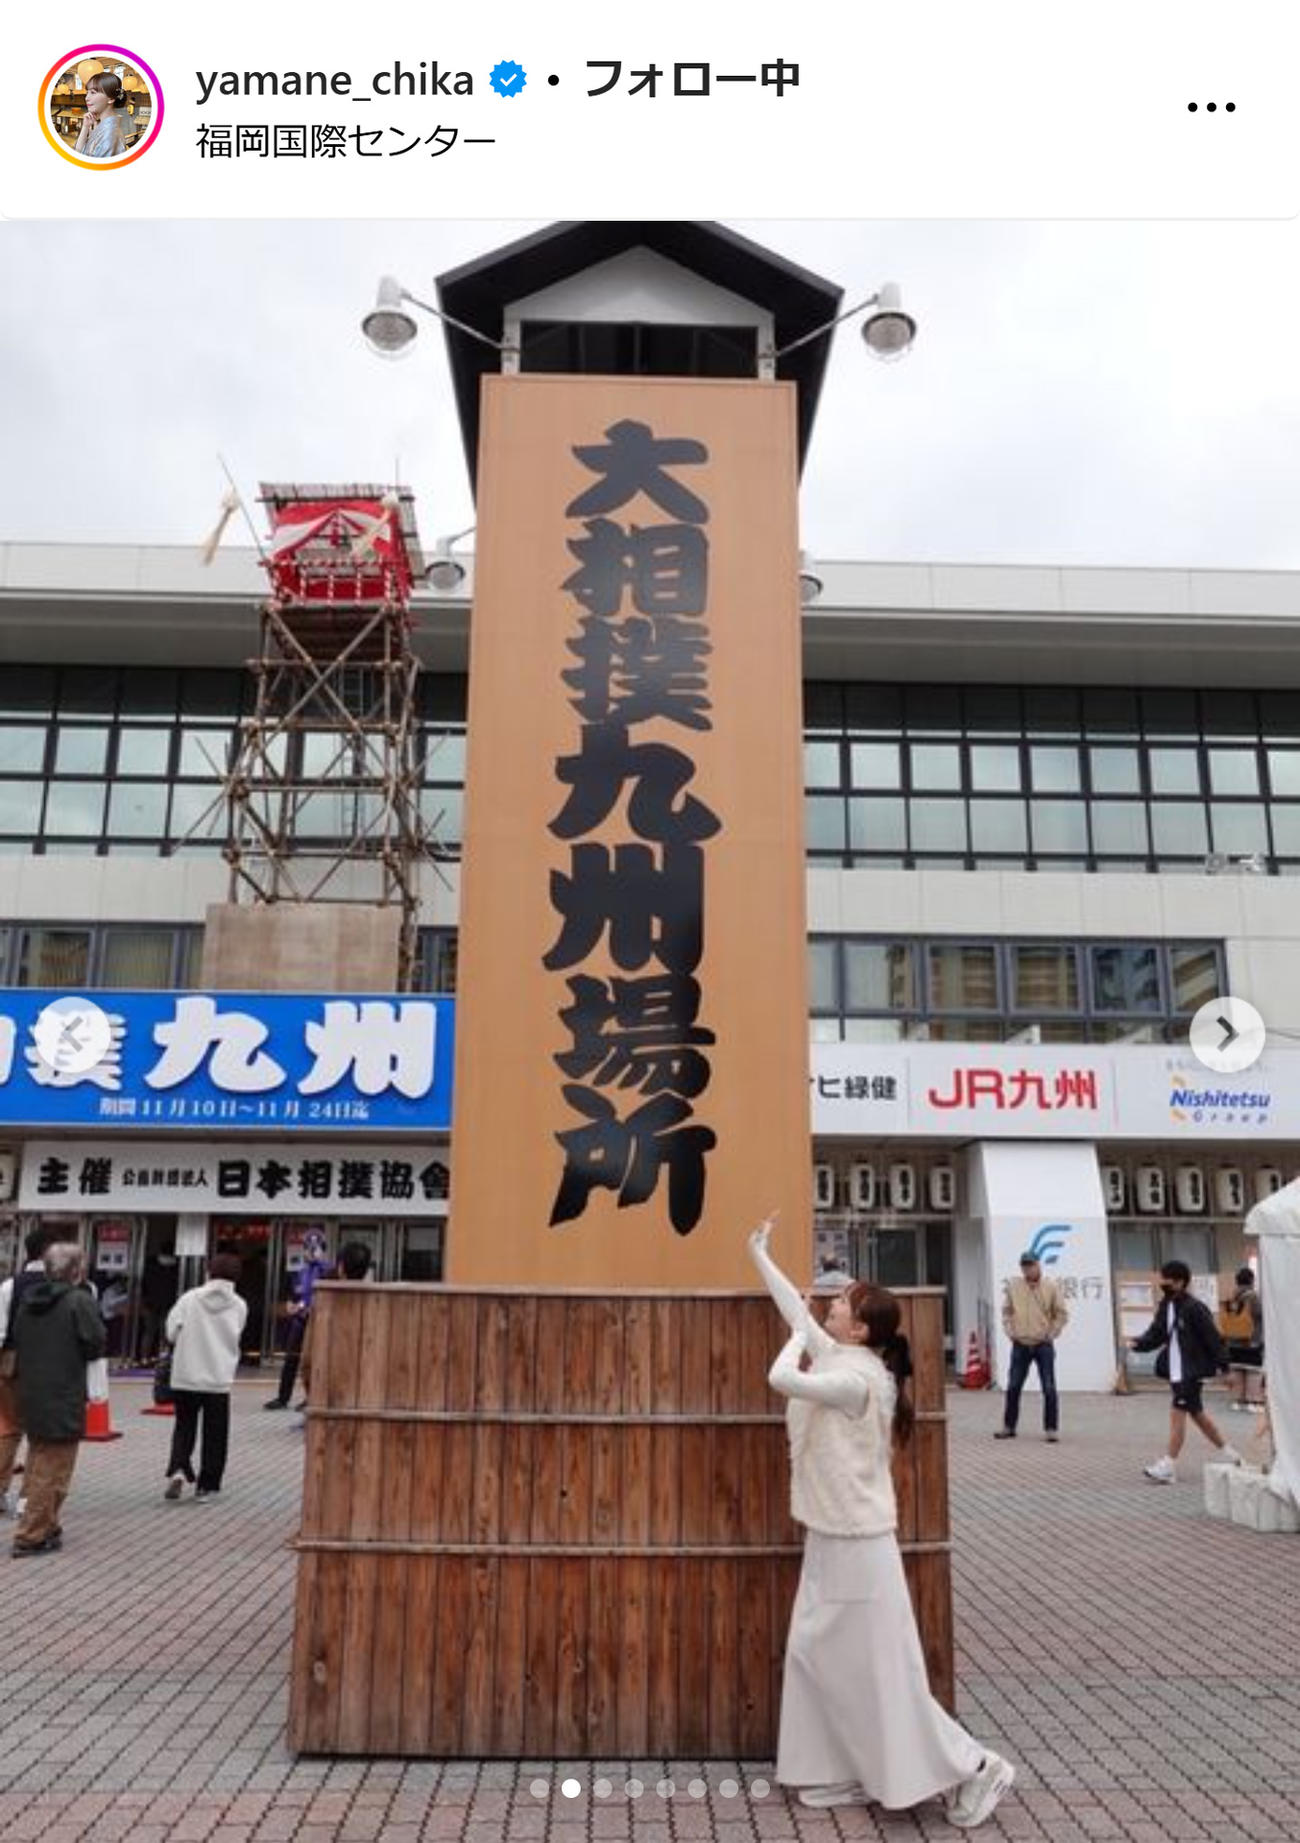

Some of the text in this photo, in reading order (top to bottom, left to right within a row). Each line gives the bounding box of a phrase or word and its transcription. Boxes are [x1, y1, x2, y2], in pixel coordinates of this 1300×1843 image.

[541, 420, 722, 1237] 大相撲九州場所
[811, 1075, 896, 1100] ヒ緑健
[929, 1069, 1098, 1110] JR九州
[1169, 1089, 1271, 1107] Nishitetsu
[37, 1157, 113, 1195] 主催
